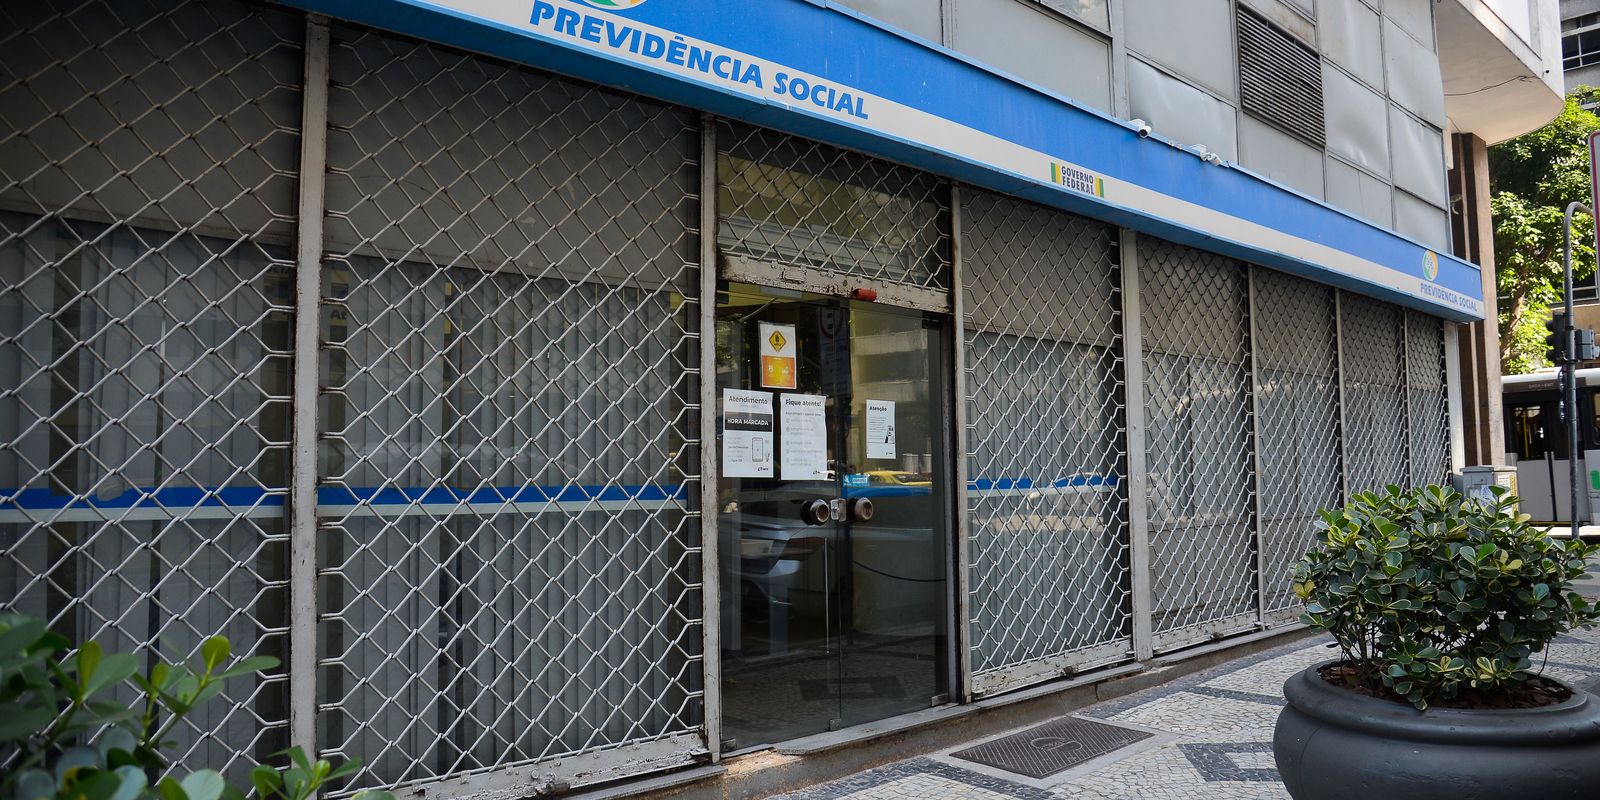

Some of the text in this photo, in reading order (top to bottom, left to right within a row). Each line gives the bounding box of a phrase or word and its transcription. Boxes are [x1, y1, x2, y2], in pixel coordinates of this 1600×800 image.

[529, 0, 869, 120] PREVIDÊNCIA SOCIAL
[1061, 166, 1094, 184] GOVERNO
[1062, 176, 1095, 195] FEDERAL
[1459, 297, 1478, 312] SOCIAL
[728, 395, 768, 405] Atendimento
[785, 399, 802, 407] Fique
